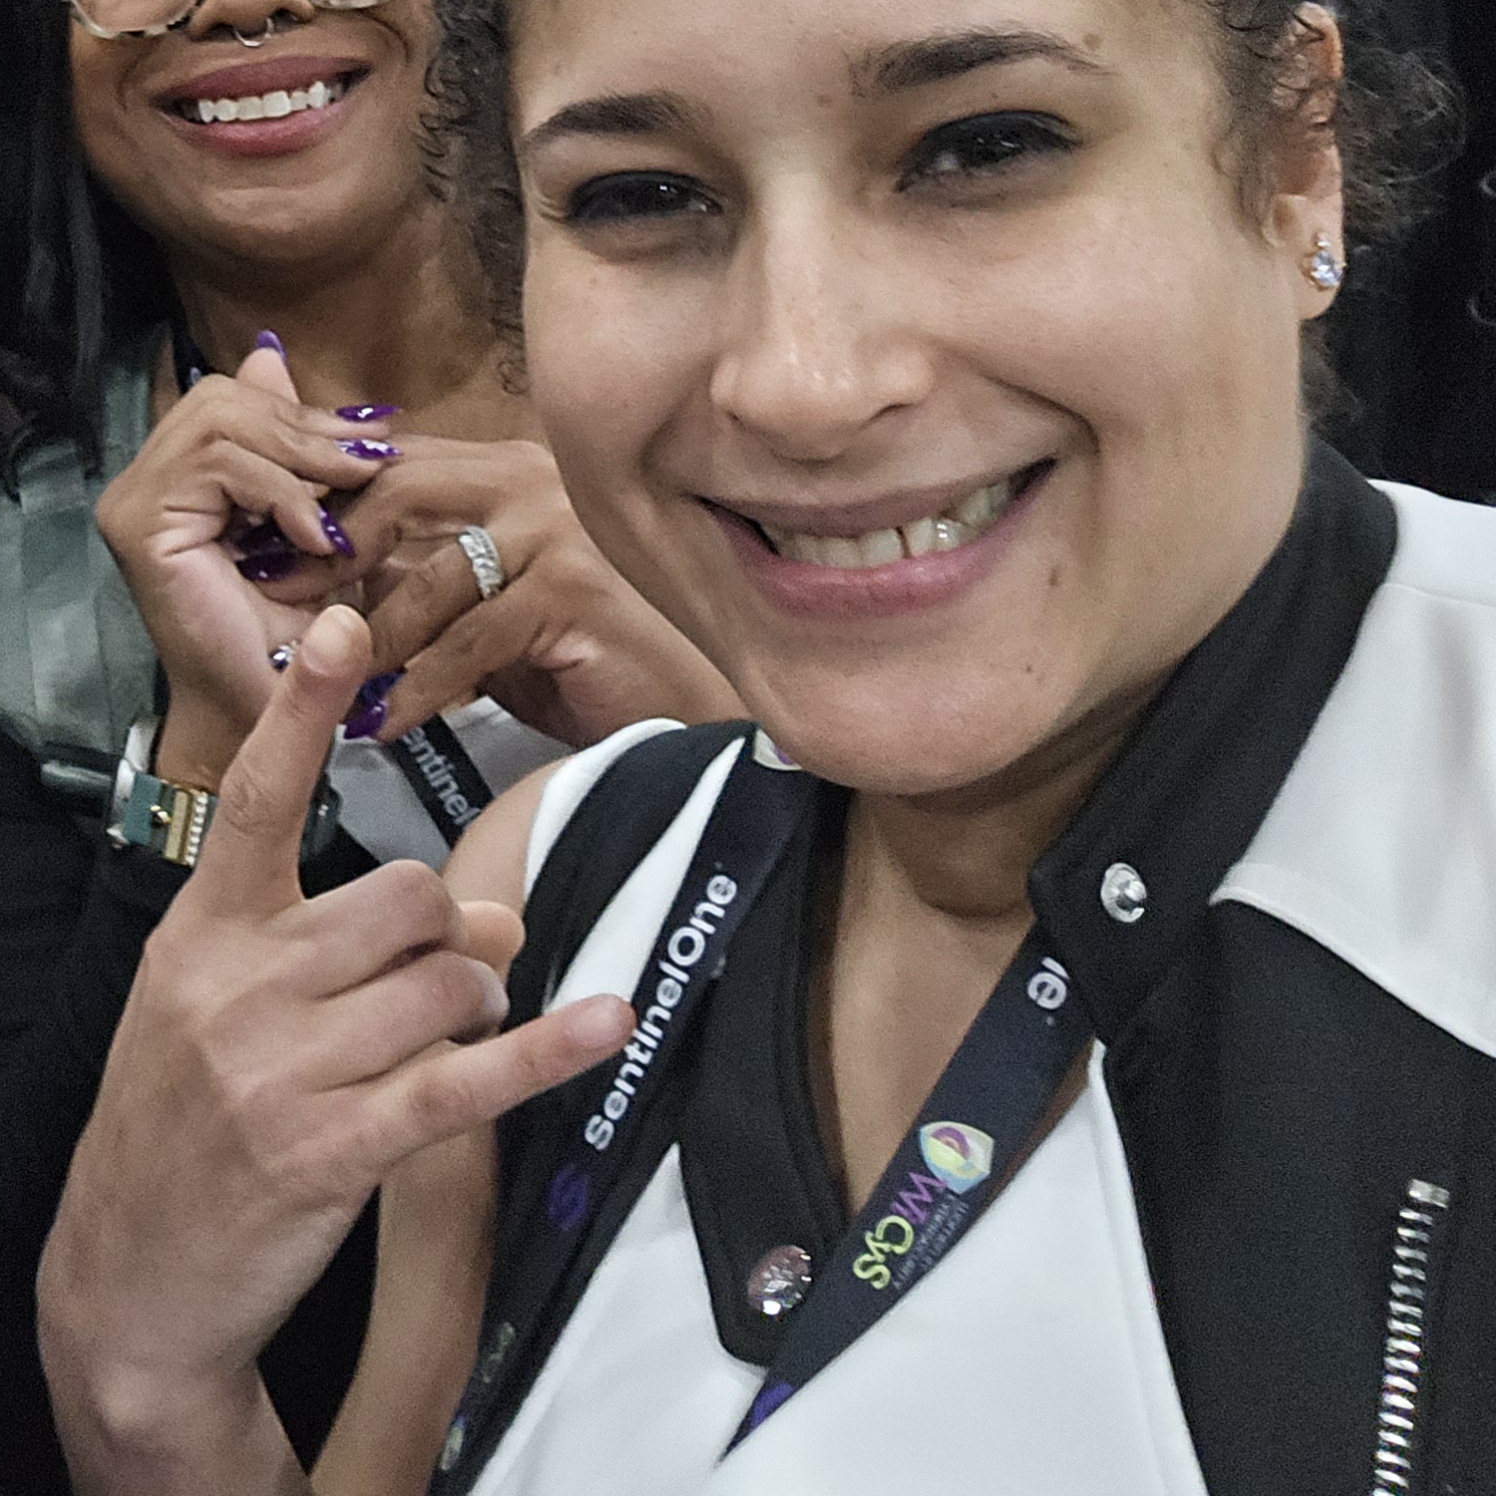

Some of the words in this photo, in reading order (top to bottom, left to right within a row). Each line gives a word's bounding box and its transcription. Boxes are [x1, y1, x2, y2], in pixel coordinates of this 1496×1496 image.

[402, 725, 482, 830] entinel
[584, 874, 737, 1150] SentinelOne
[852, 1171, 949, 1291] WiCyS
